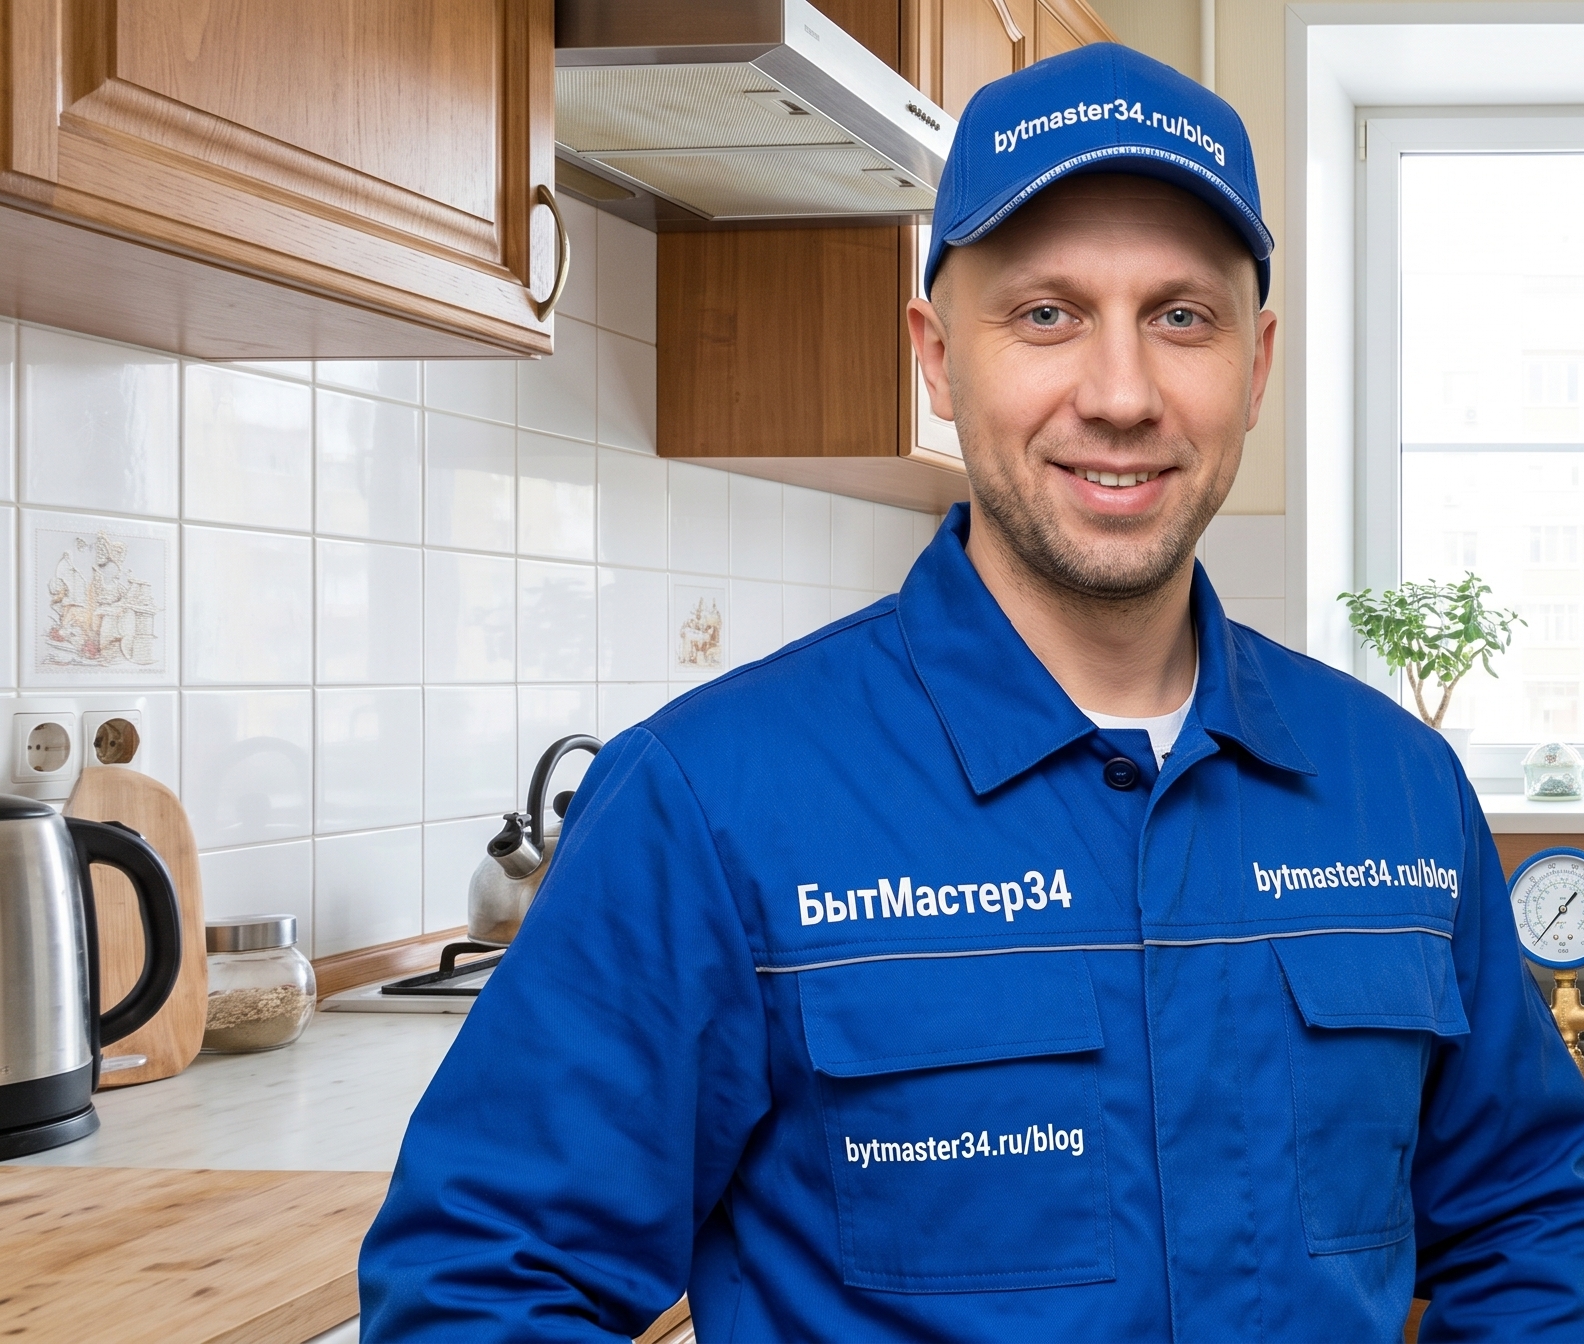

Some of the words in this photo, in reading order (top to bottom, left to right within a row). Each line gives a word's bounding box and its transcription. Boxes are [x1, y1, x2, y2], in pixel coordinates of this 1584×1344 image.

[994, 98, 1226, 167] bytmaster34.ru/blog
[797, 869, 1073, 926] БытМастер34
[1252, 858, 1459, 900] bytmaster34.ru/blog
[845, 1123, 1085, 1169] bytmaster34.ru/blog
